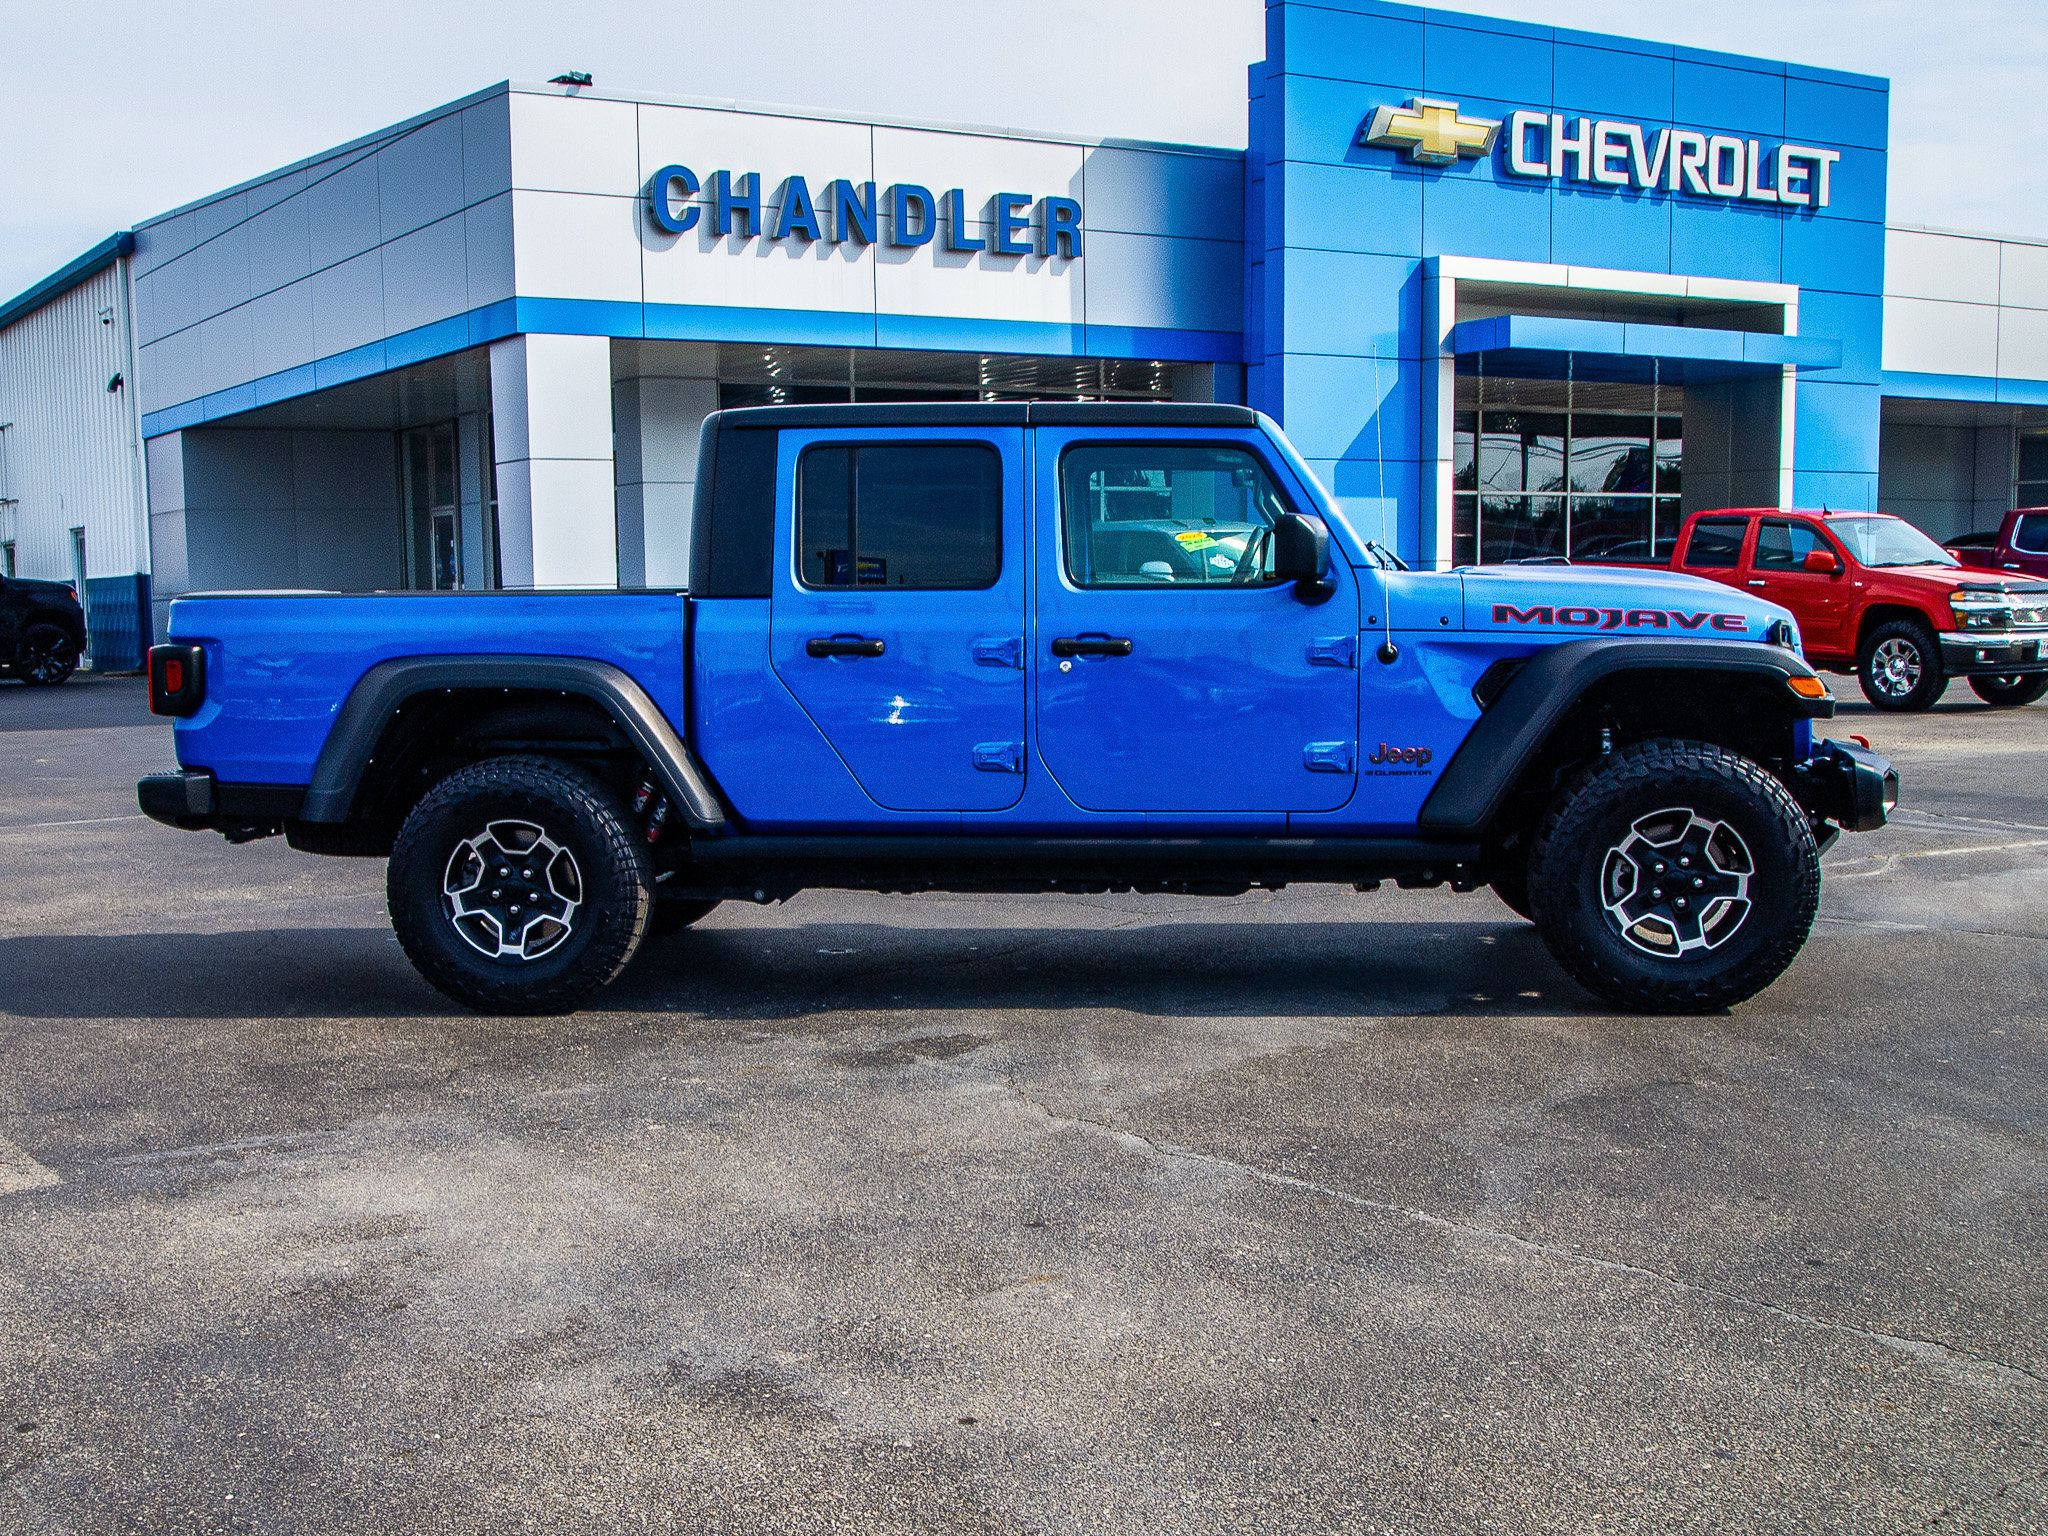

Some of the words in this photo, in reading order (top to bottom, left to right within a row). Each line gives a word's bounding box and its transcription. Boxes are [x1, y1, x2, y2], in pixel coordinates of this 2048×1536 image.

[1505, 109, 1841, 208] CHEVROLET
[648, 163, 1084, 259] CHANDLER
[1491, 603, 1750, 633] MOJAVE
[1369, 742, 1432, 768] Jeep
